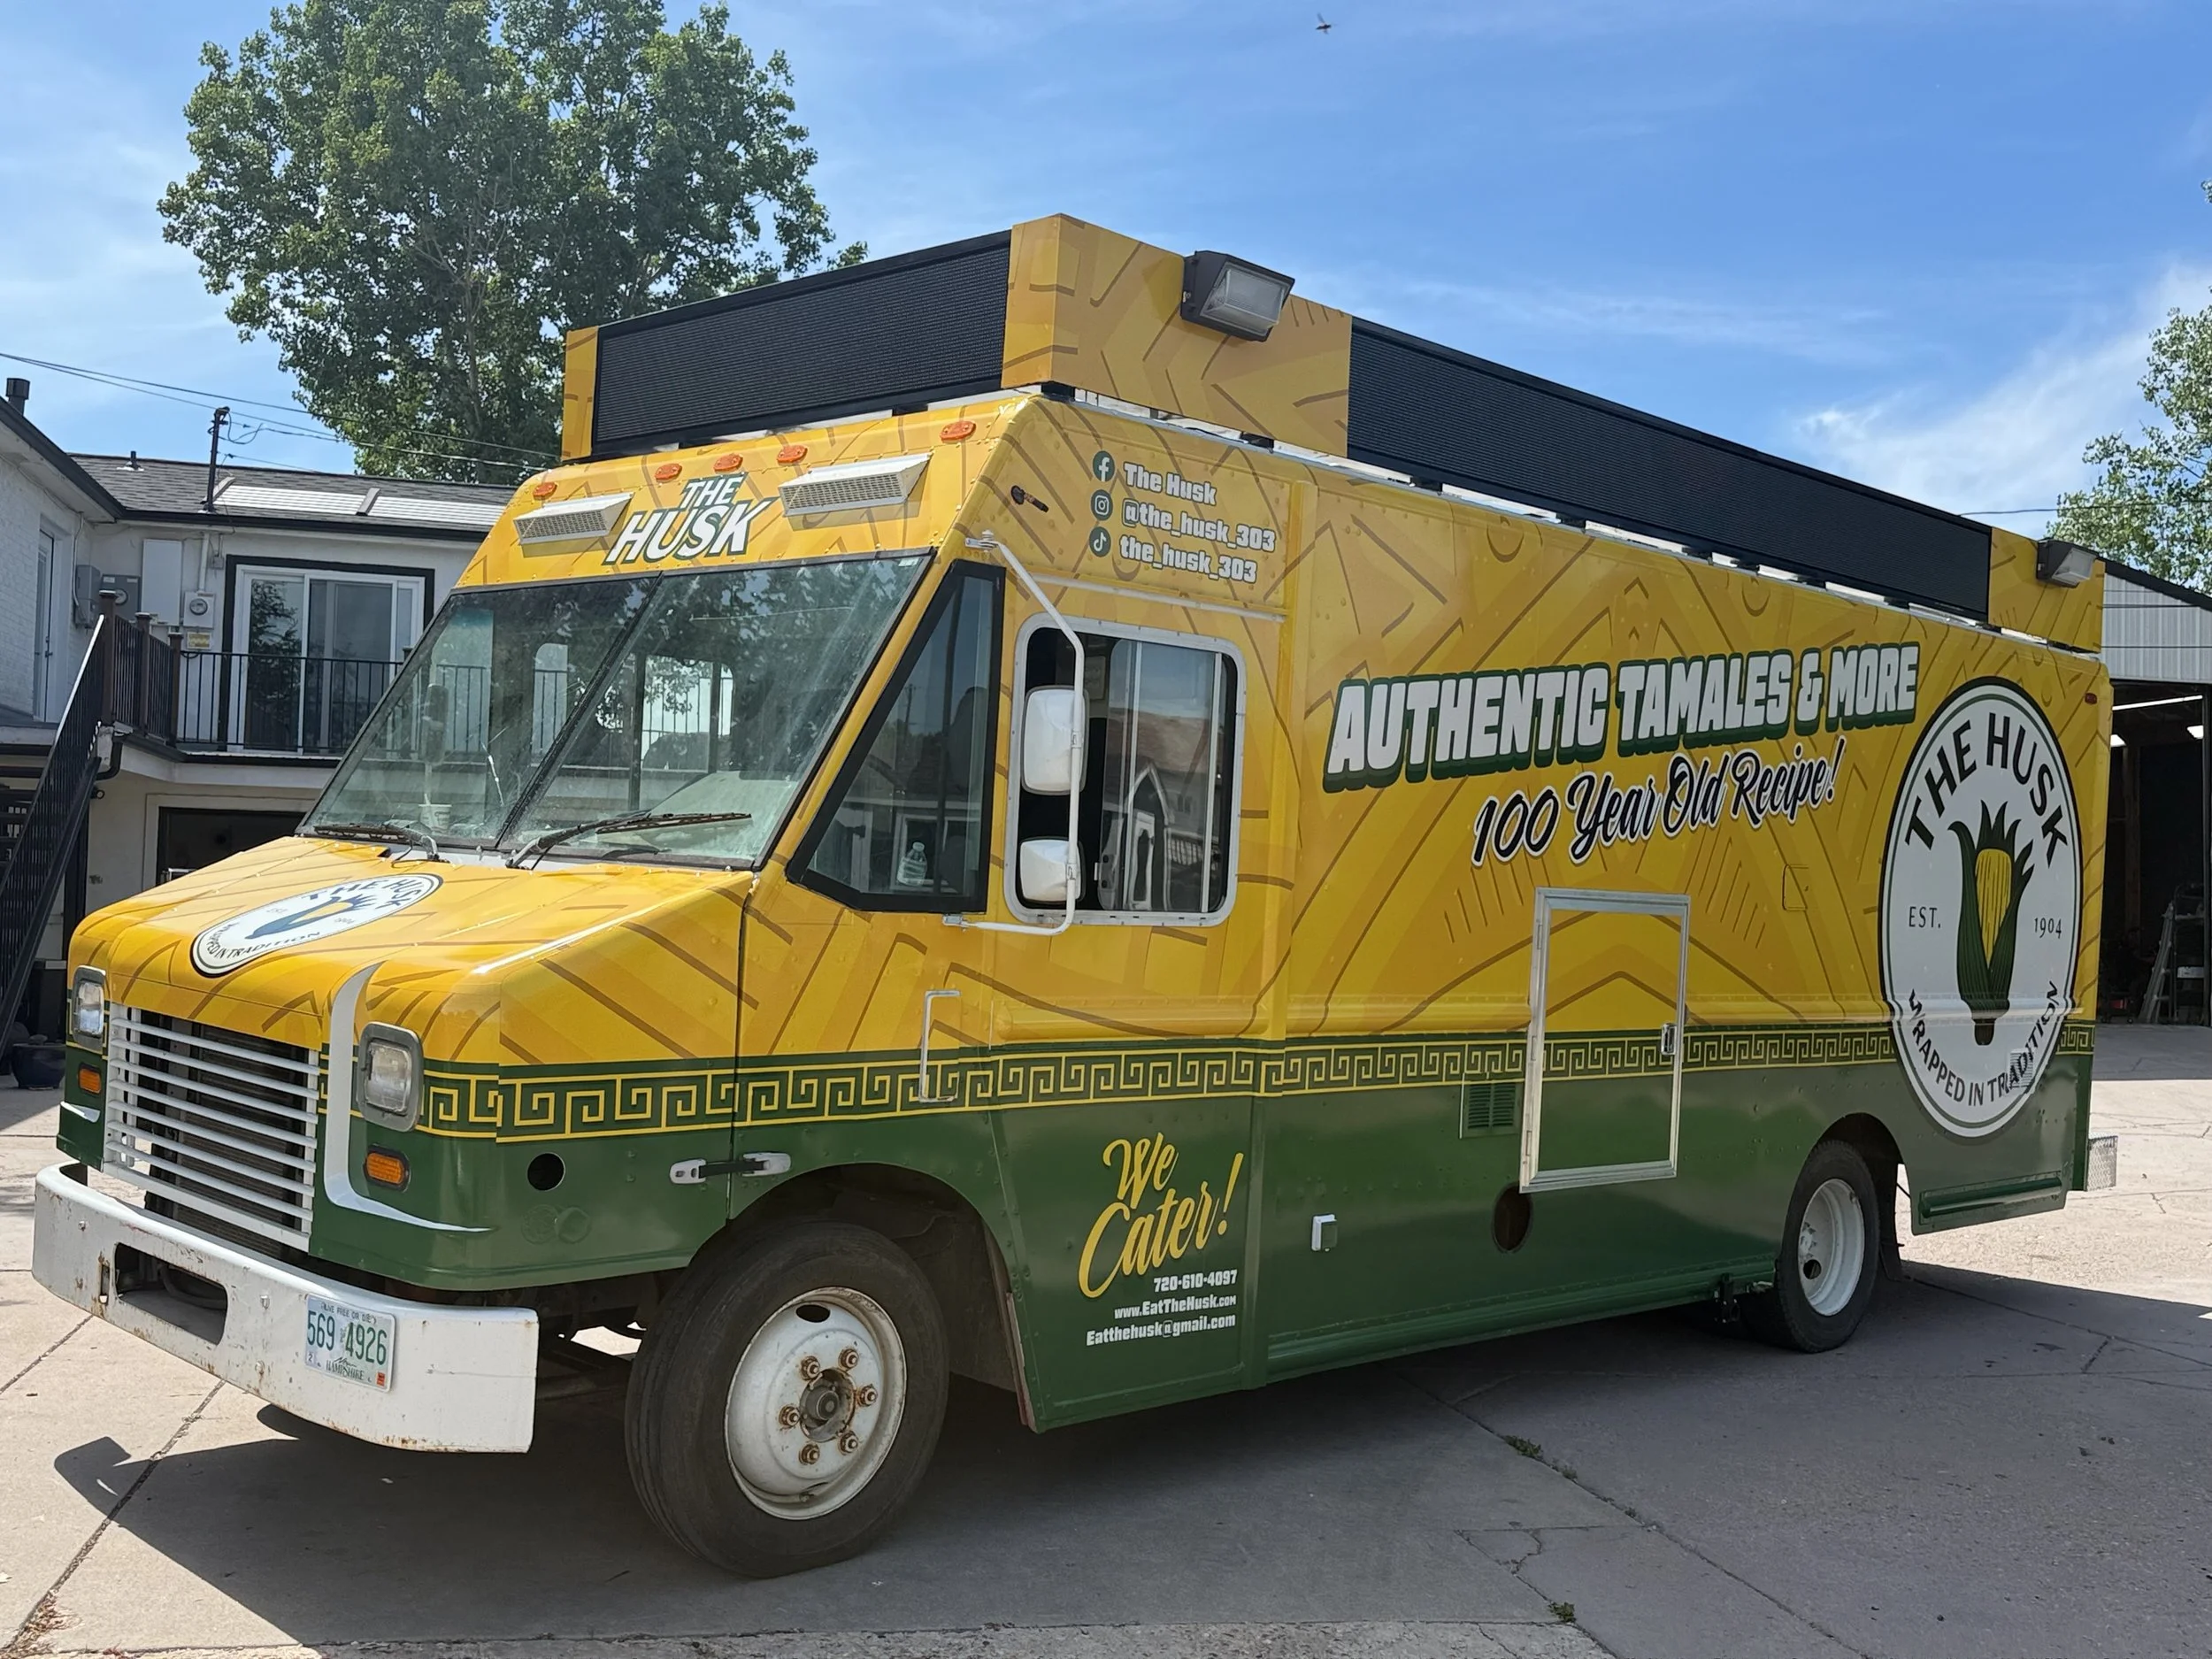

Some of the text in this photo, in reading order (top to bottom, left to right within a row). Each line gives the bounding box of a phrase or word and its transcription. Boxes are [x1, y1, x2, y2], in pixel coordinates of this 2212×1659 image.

[680, 473, 748, 509] THE
[1124, 461, 1217, 506] The Husk
[602, 497, 777, 565] HUSK
[1122, 498, 1276, 552] @the_husk_303
[1119, 534, 1258, 583] the_husk_303
[1325, 641, 1922, 793] AUTHENTIC TAMALES & MORE
[1469, 735, 1847, 867] 100 Year Old Recipe!
[1904, 712, 2069, 868] THE HUSK
[1909, 907, 2062, 940] EST. 1904
[1909, 980, 2059, 1106] WRAPPED IN TRADITION
[1102, 1132, 1179, 1210] We
[1079, 1152, 1244, 1298] Cater!
[307, 1310, 387, 1364] 569 4926
[1086, 1314, 1236, 1347] Eatthehusk@gmail.com
